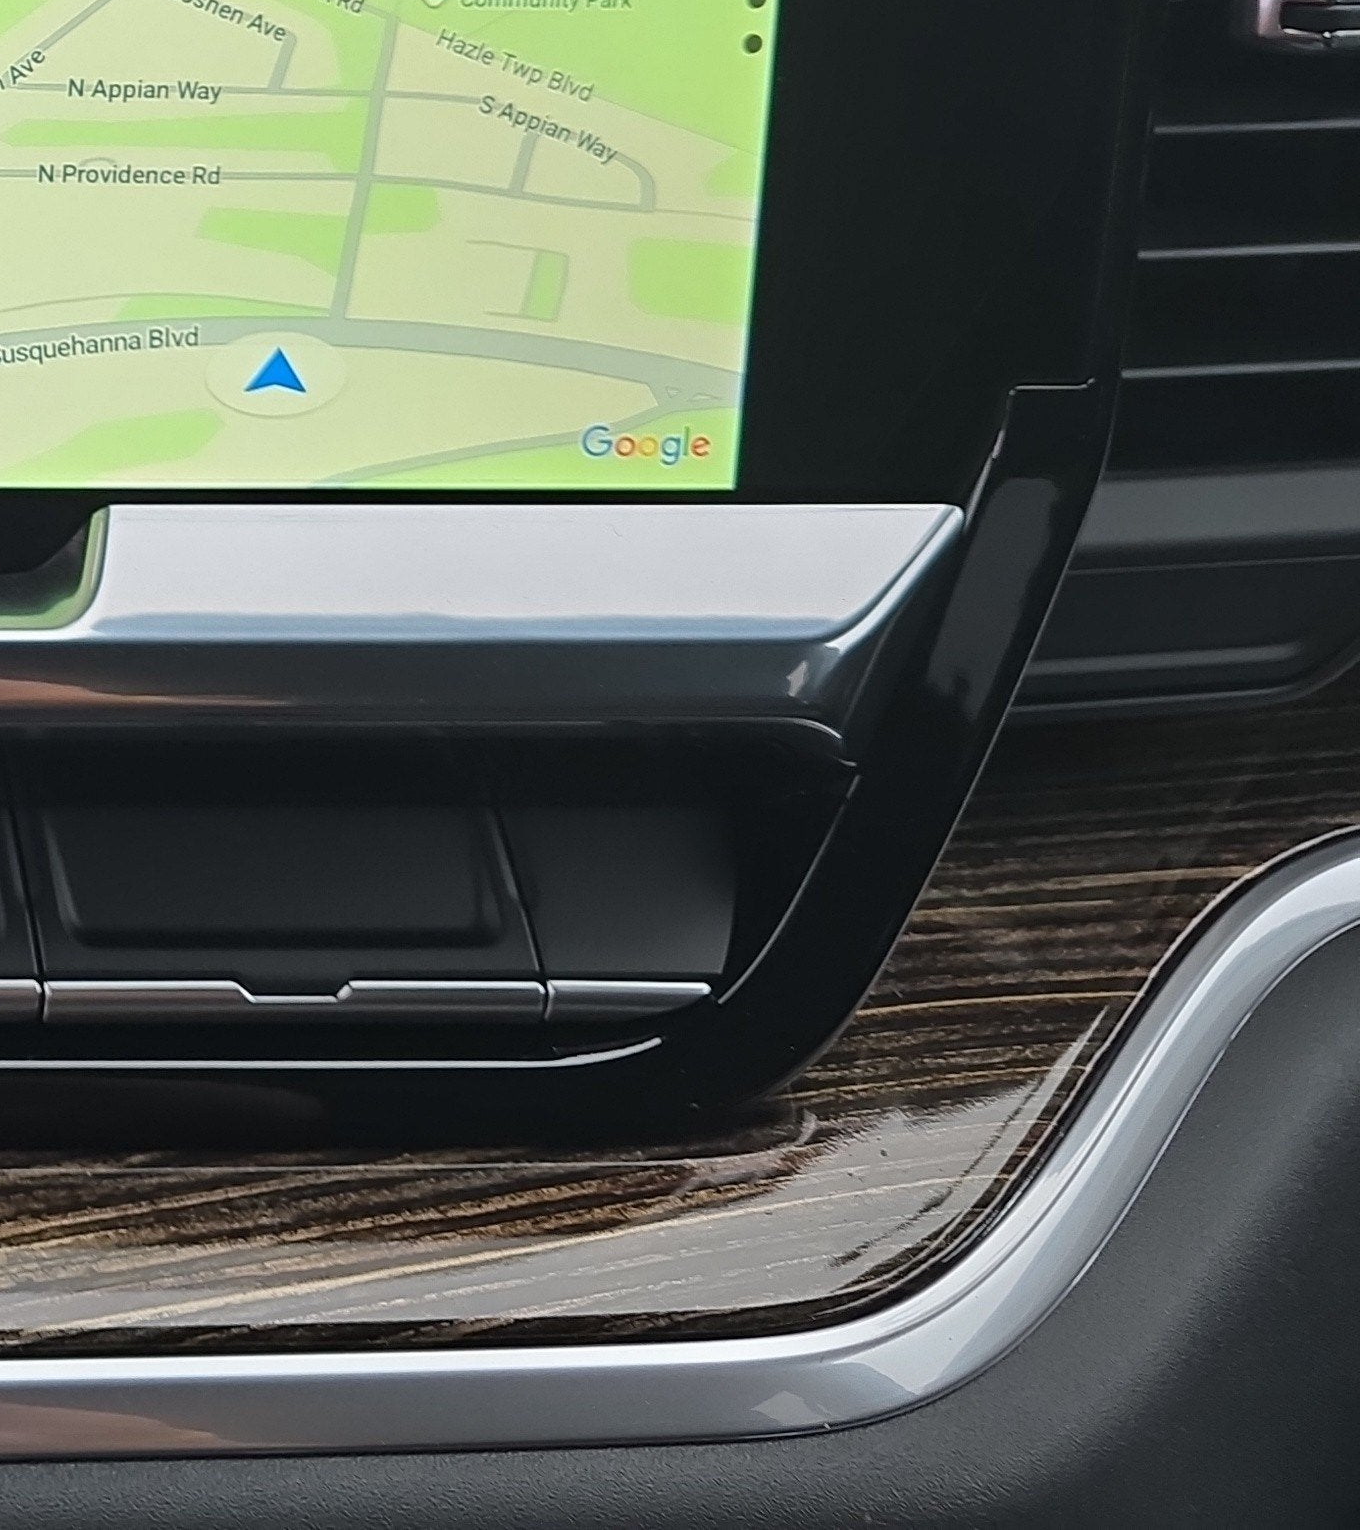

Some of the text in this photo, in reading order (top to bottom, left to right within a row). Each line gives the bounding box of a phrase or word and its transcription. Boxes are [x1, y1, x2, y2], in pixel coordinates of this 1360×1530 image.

[247, 14, 287, 42] Ave
[9, 49, 46, 85] Ave
[435, 28, 595, 102] Hazle Twp Blvd
[67, 78, 222, 105] N Appian Way
[478, 95, 619, 166] S Appian Way
[37, 164, 221, 185] N Providence Rd
[148, 326, 199, 349] Blvd
[583, 425, 711, 466] Google
